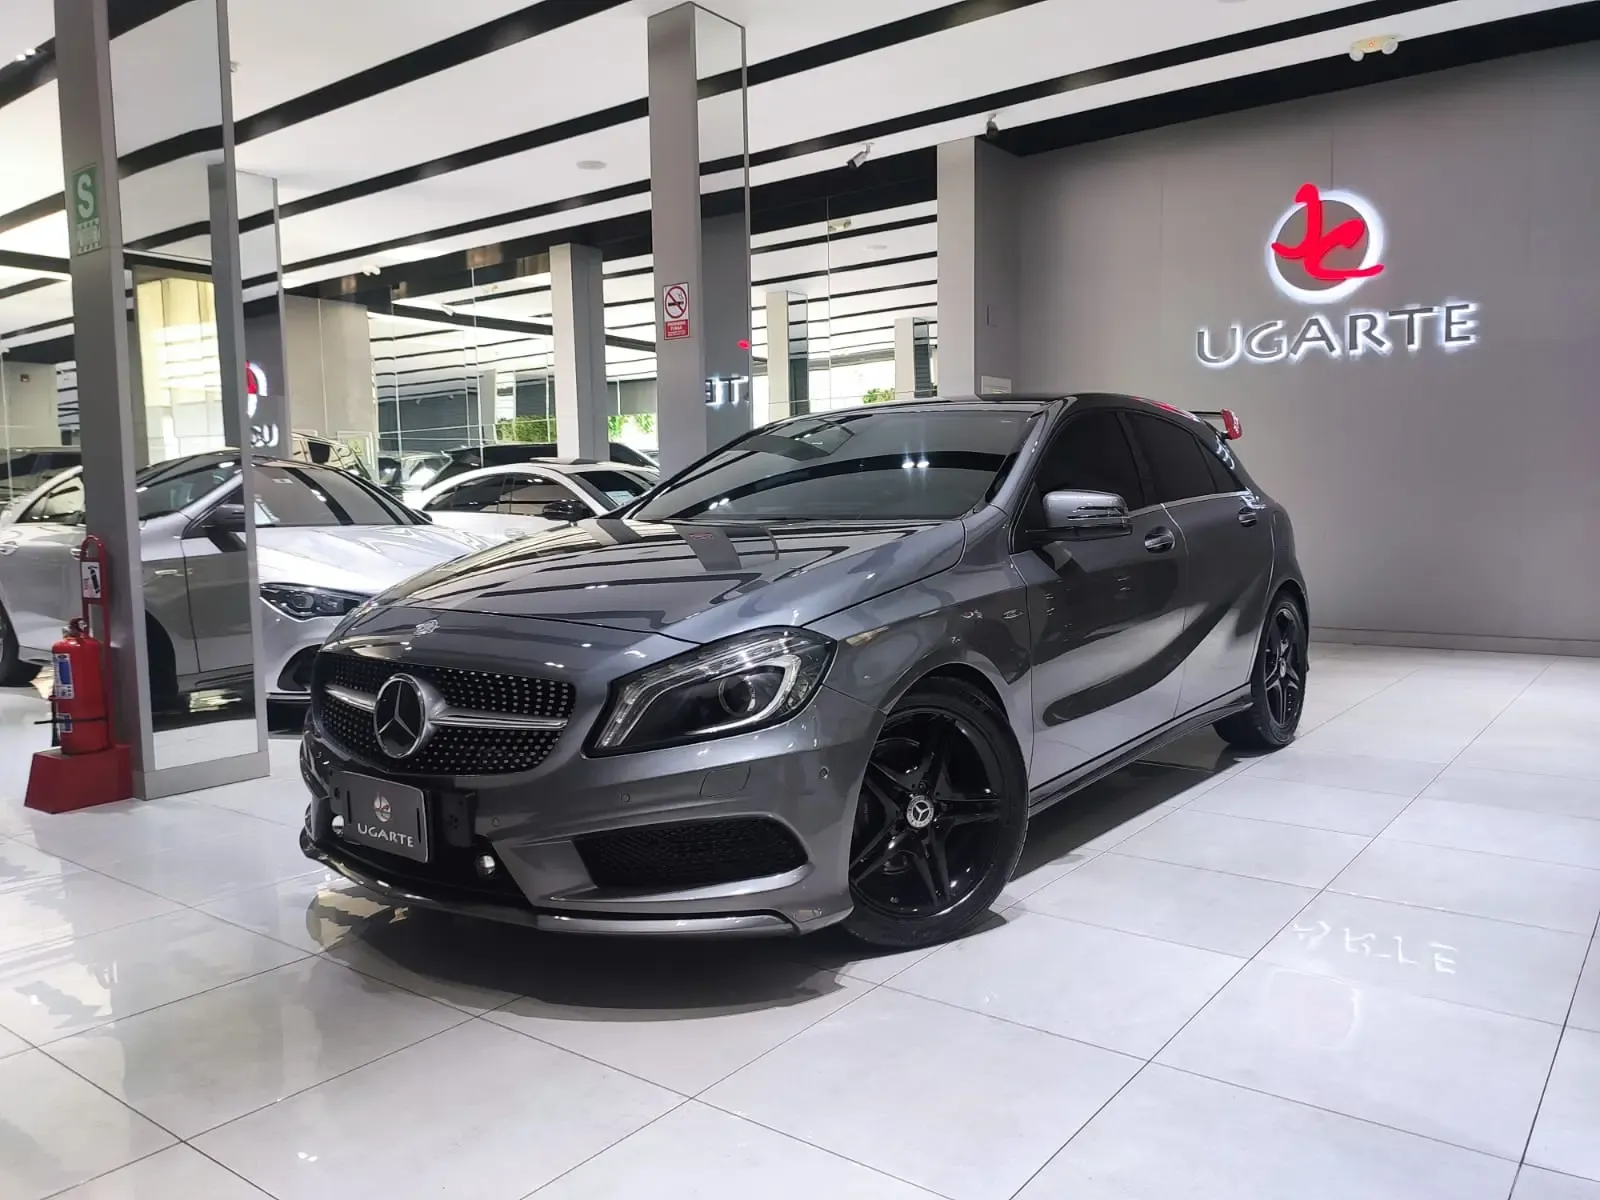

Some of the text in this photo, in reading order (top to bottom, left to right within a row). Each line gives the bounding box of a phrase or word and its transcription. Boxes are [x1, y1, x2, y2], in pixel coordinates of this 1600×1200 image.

[77, 173, 94, 219] S
[1195, 301, 1478, 368] UGARTE
[357, 823, 414, 848] UGARTE
